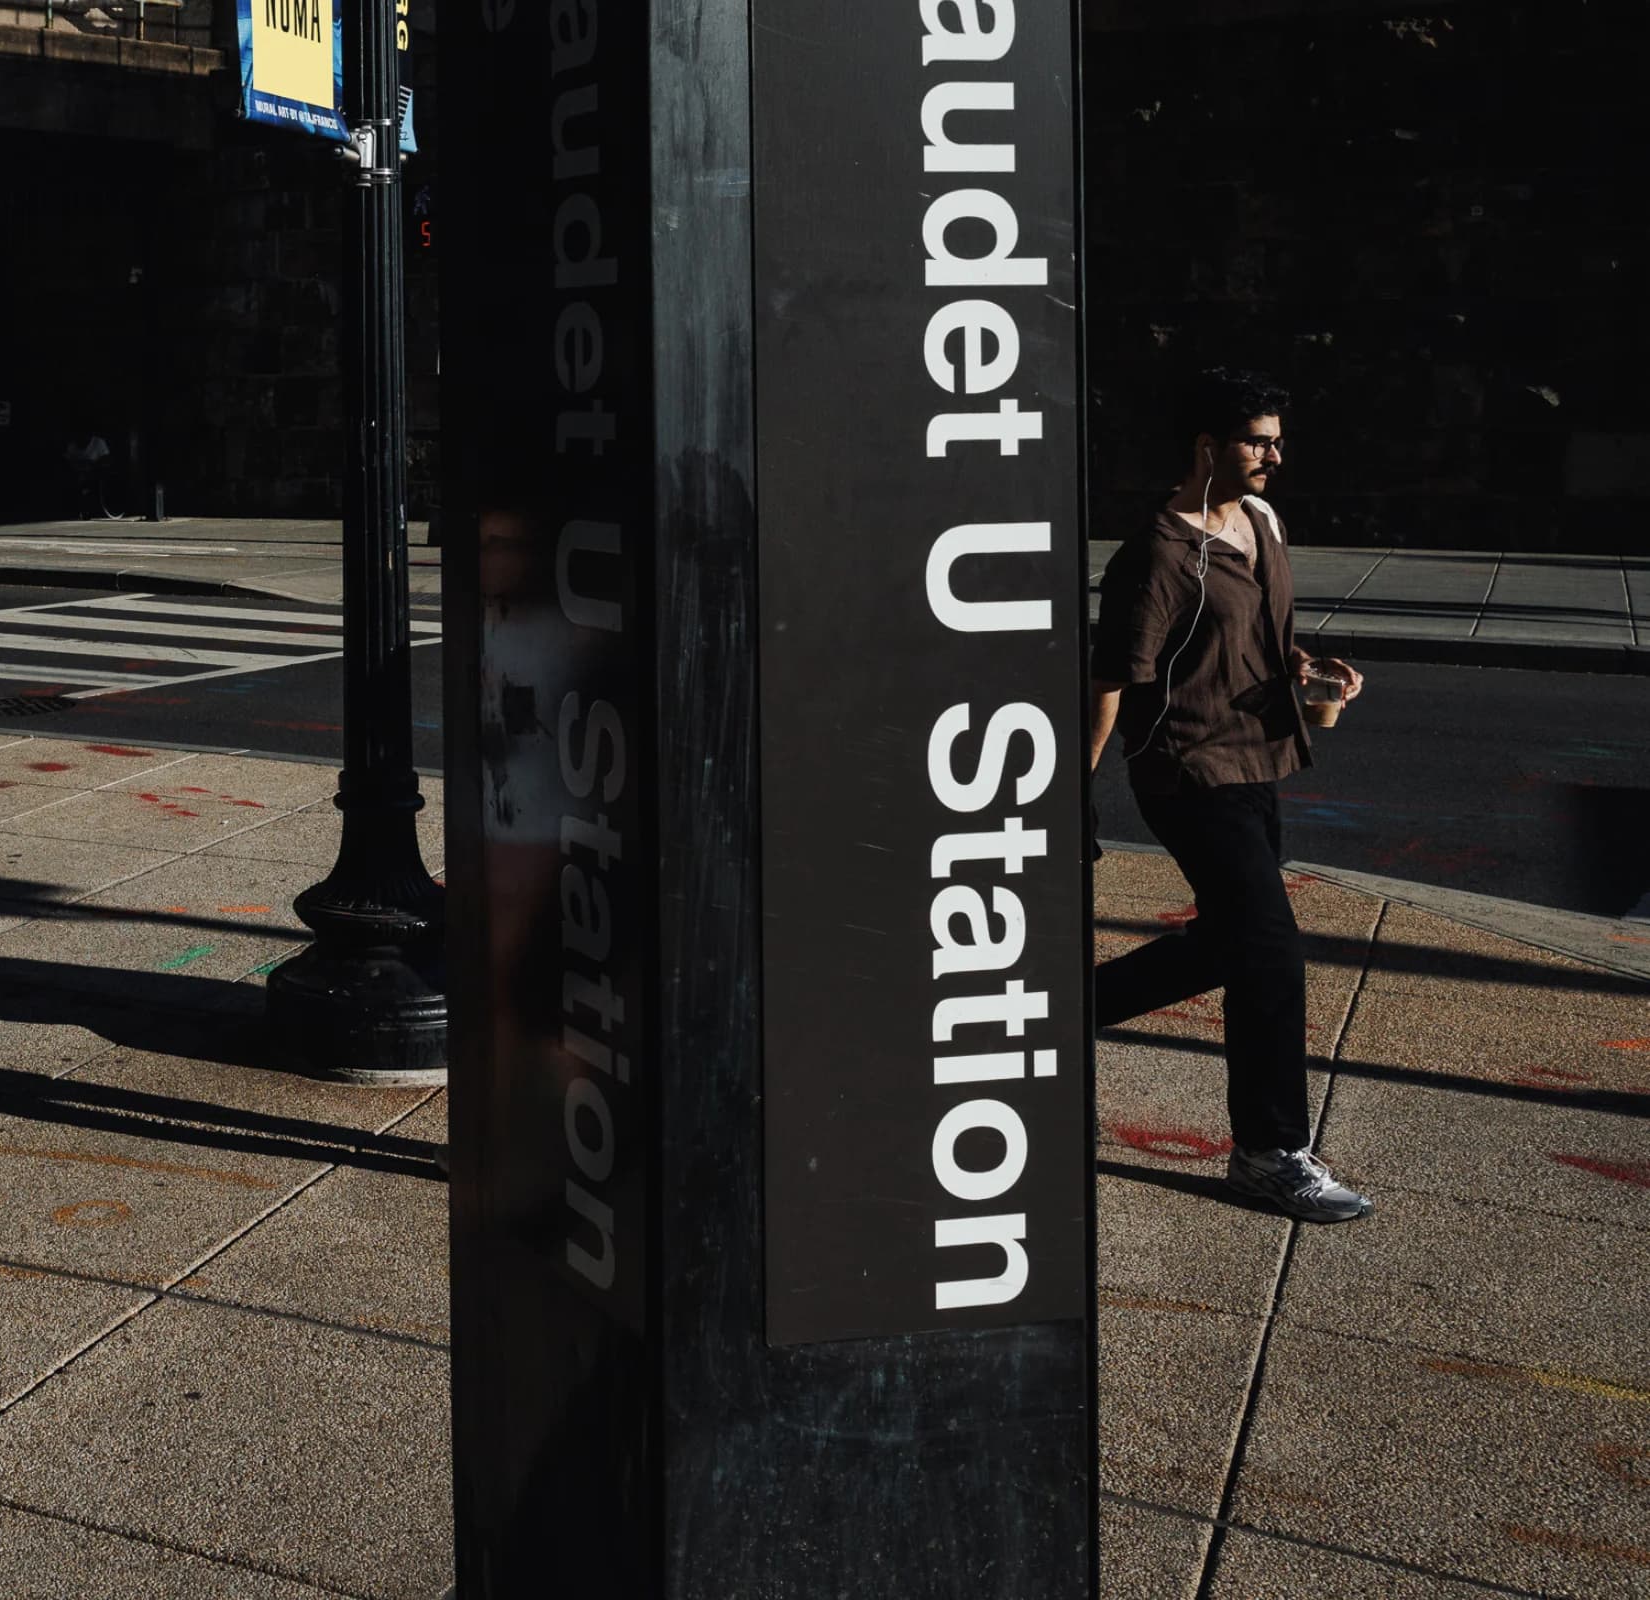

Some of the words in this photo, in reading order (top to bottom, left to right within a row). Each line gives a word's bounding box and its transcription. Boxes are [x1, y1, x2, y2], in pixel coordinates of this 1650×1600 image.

[556, 519, 622, 632] U
[925, 521, 1052, 632] U
[557, 689, 630, 1291] Station
[927, 701, 1057, 1309] Station
